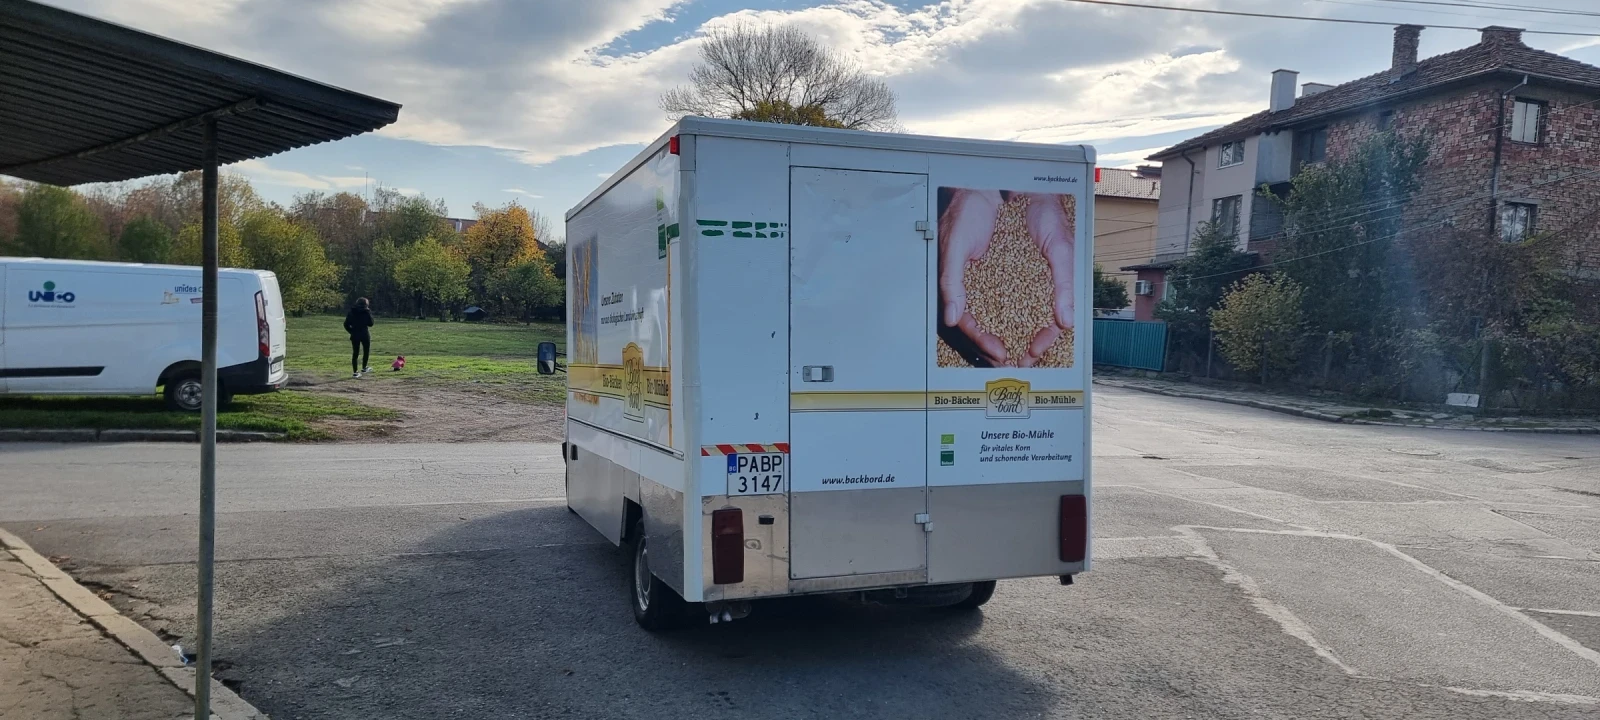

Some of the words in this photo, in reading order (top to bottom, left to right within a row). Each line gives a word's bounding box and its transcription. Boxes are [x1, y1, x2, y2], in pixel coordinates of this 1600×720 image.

[174, 284, 197, 293] unidea
[989, 386, 1025, 404] Back
[934, 396, 980, 405] Bio-Bäcker
[1034, 396, 1076, 404] Bio-Mühle
[980, 430, 1010, 440] Unsere
[1012, 430, 1054, 440] Bio-Mühle
[980, 445, 990, 454] für
[1031, 454, 1072, 463] Verarbeitung
[738, 456, 782, 473] PABP
[738, 475, 782, 492] 3147
[822, 474, 895, 485] www.backbord.de
